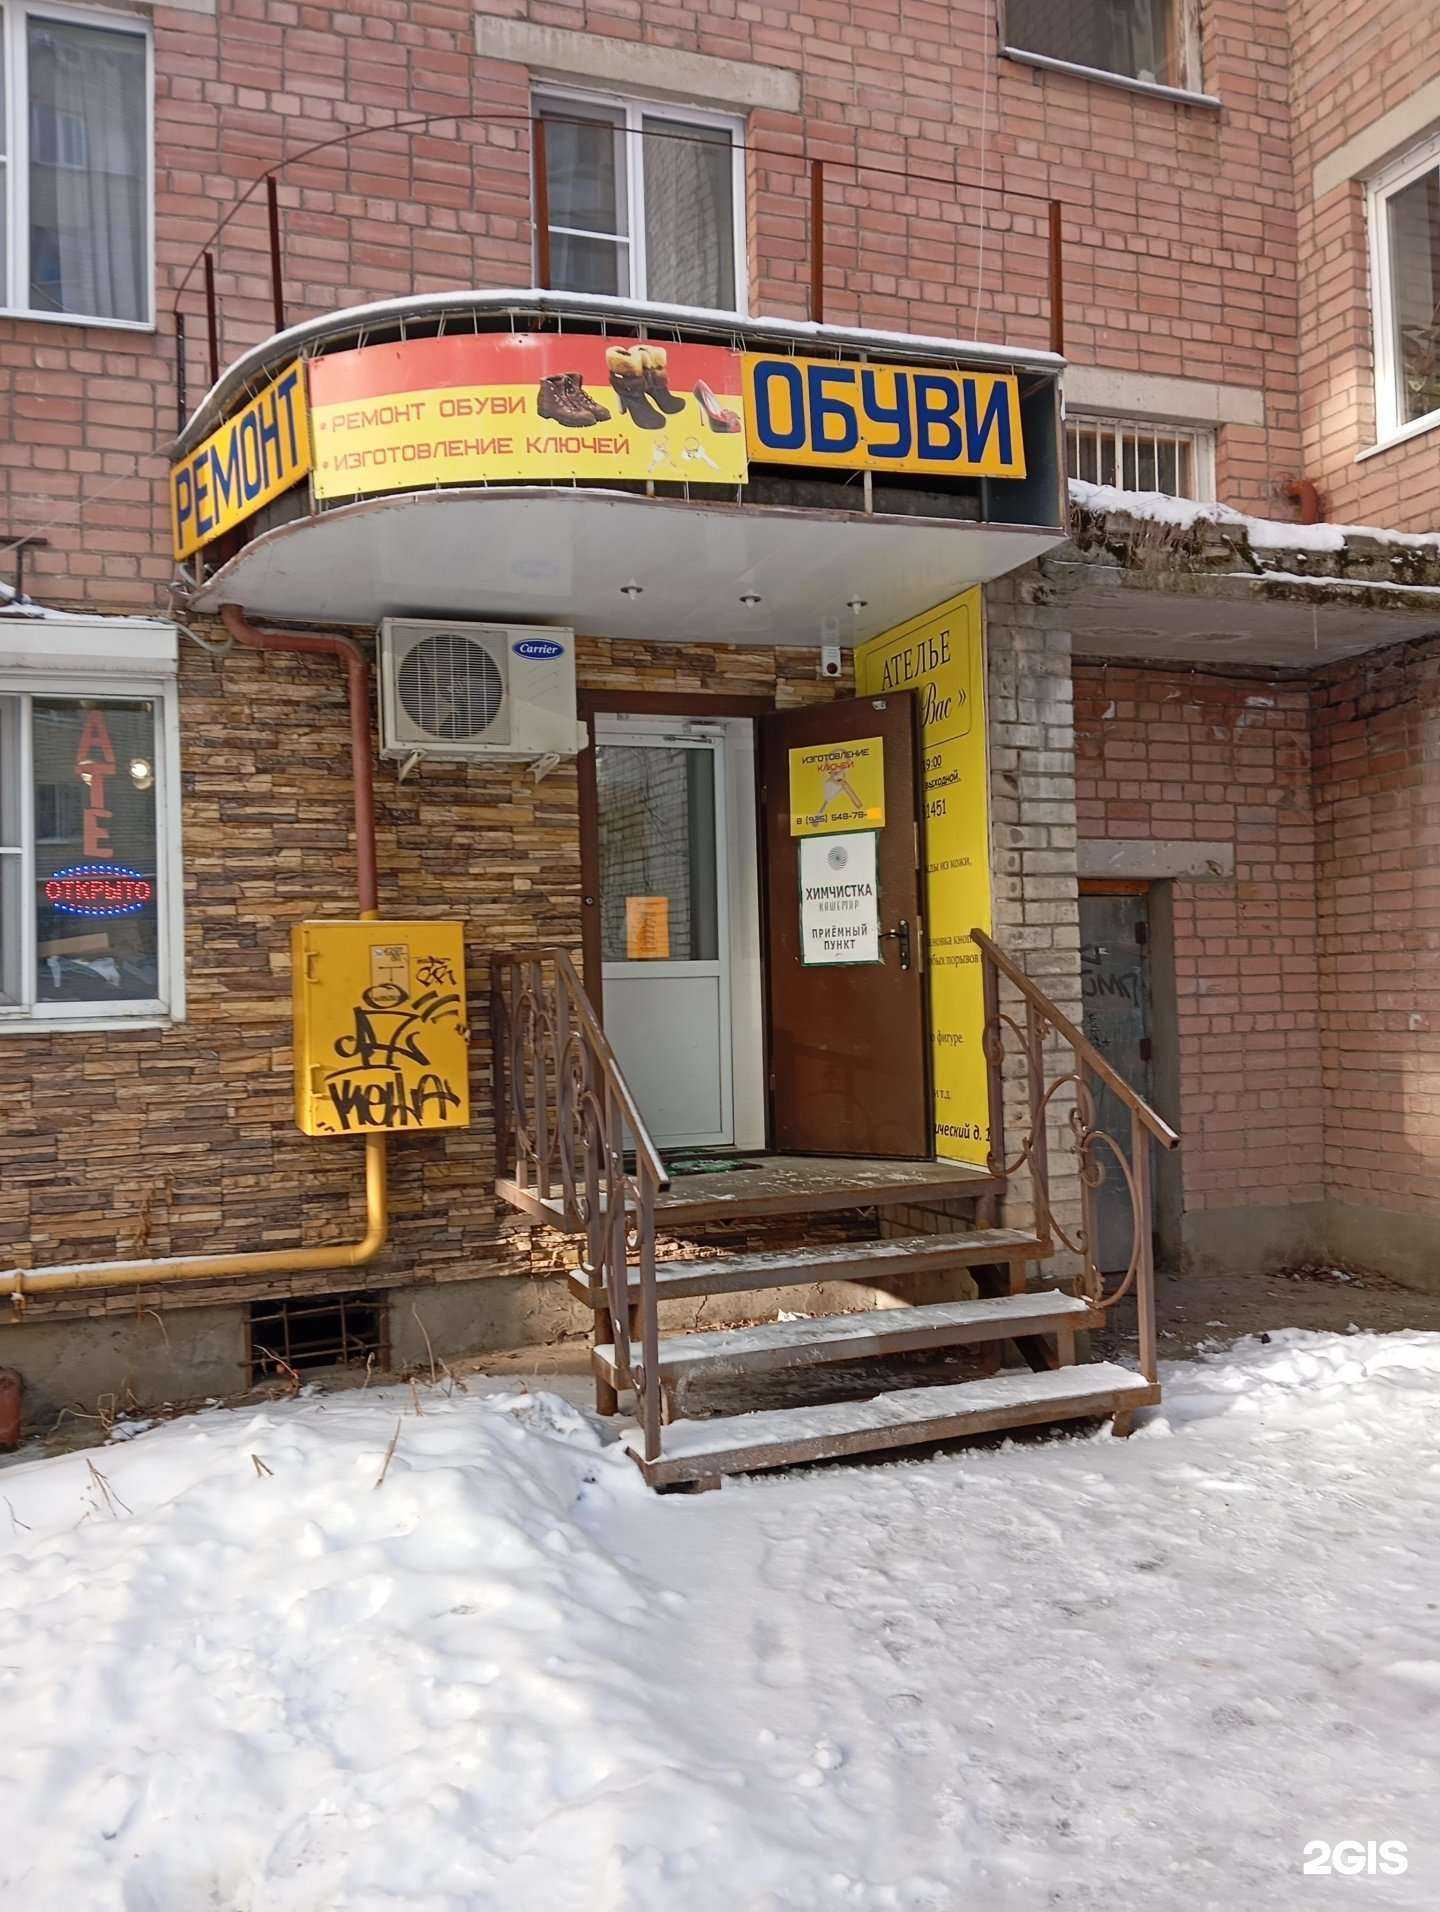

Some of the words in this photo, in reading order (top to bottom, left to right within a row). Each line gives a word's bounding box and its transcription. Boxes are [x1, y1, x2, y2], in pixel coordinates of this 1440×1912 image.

[332, 402, 426, 433] РЕМОНТ
[438, 395, 526, 419] ОБУВИ
[753, 360, 1014, 466] ОБУВИ
[176, 371, 298, 551] РЕМОНТ
[333, 437, 514, 472] ИЗГОТОВЛЕНИЕ
[526, 433, 631, 457] КЛЮЧЕЙ
[519, 643, 559, 655] Carrier
[881, 630, 951, 692] АТЕЛЬЕ
[921, 682, 952, 729] Вас
[801, 749, 870, 764] ИЗГОТОВЛЕНИЕ
[46, 880, 151, 900] ОТКРЫТО
[805, 884, 873, 900] ХИМЧИСТКА
[812, 923, 868, 938] ПРИЁМНЫЙ
[824, 940, 856, 951] ПУНКТ
